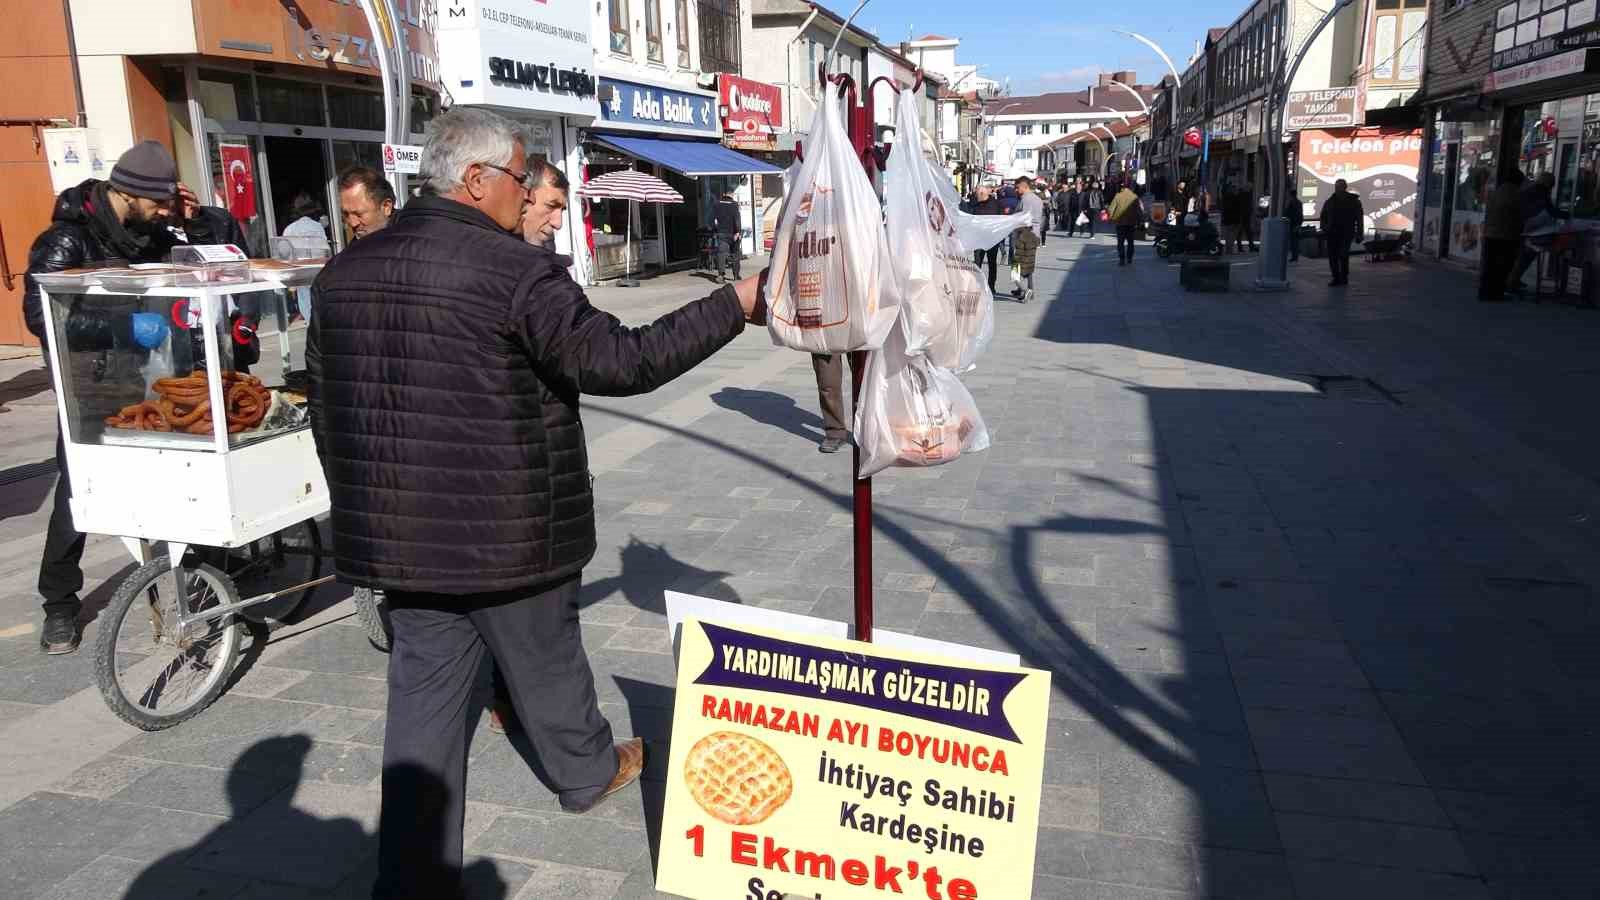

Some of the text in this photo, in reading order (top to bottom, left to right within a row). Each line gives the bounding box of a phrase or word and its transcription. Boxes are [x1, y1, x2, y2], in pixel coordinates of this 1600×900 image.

[632, 90, 695, 125] Ada Balık
[1290, 88, 1355, 103] CEP TELEFONU
[1303, 102, 1339, 114] TAMİRİ
[396, 148, 419, 161] ÖMER
[1310, 137, 1384, 154] Telefon
[722, 643, 990, 716] YARDIMLAŞMAK GÜZELDİR
[701, 694, 1010, 776] RAMAZAN AYI BOYUNCA
[818, 750, 1016, 823] İhtiyaç Sahibi
[685, 824, 705, 857] 1
[840, 801, 985, 858] Kardeşine
